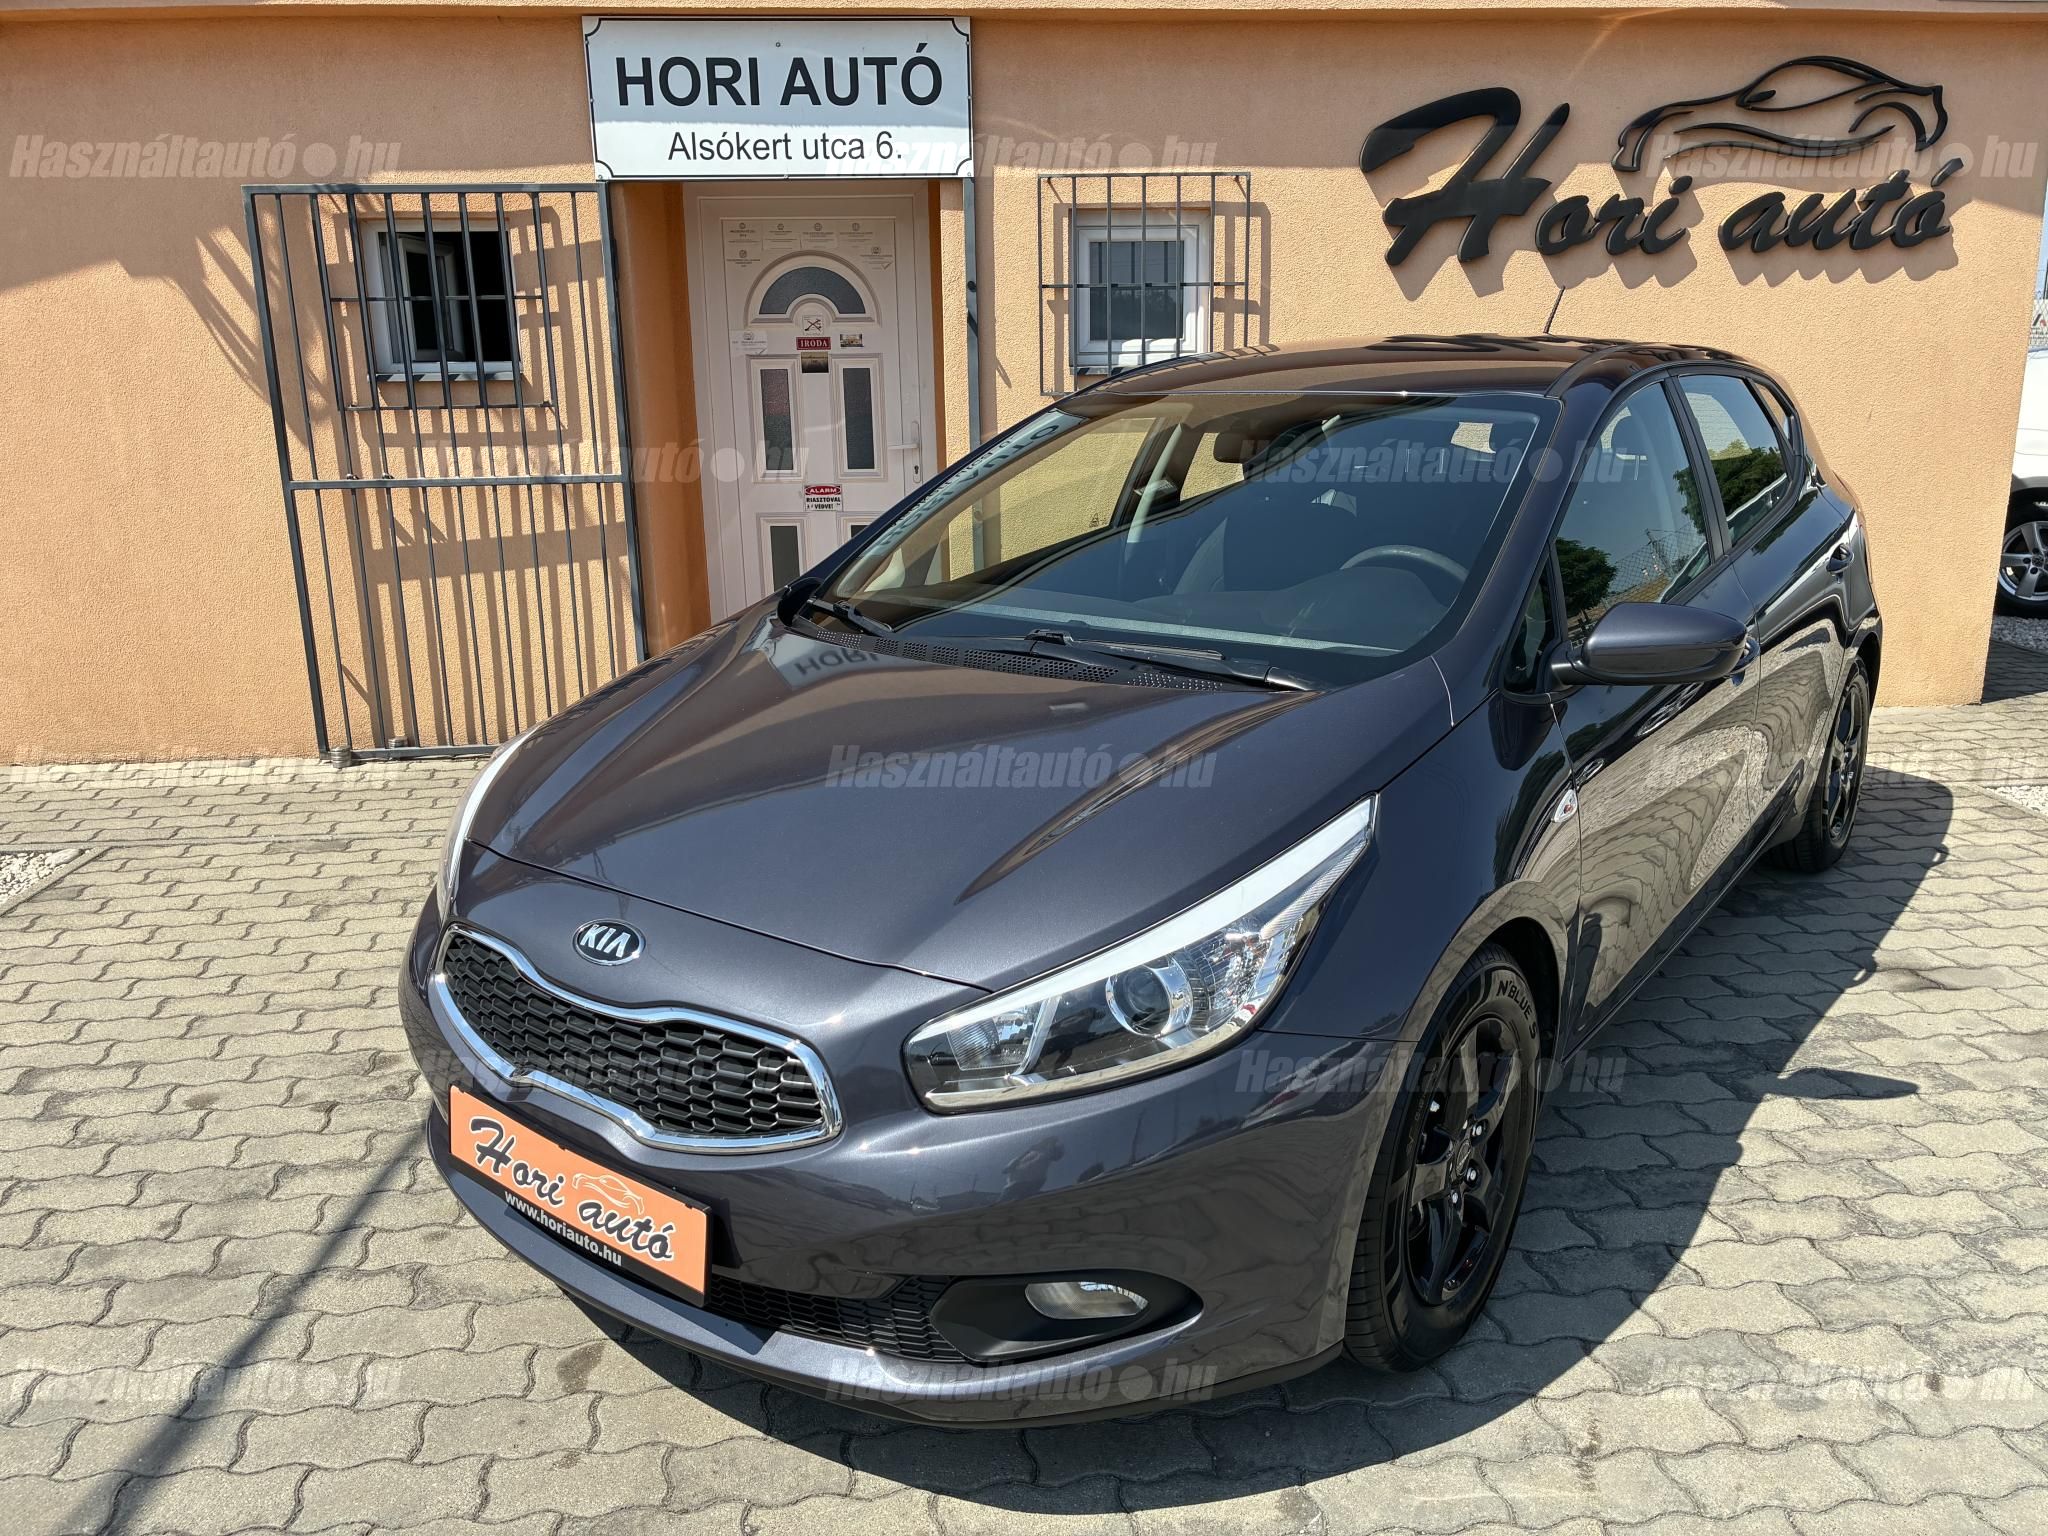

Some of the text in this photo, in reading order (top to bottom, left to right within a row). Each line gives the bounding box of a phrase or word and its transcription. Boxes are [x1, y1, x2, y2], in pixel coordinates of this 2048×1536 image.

[616, 42, 943, 106] HORI AUTÓ
[668, 131, 903, 161] Alsókert utca 6.
[1359, 86, 1964, 266] Hori autó
[800, 339, 828, 347] IRODA
[580, 924, 631, 958] KIA
[470, 1117, 674, 1259] Hori autó
[504, 1190, 622, 1267] www.horiauto.hu
